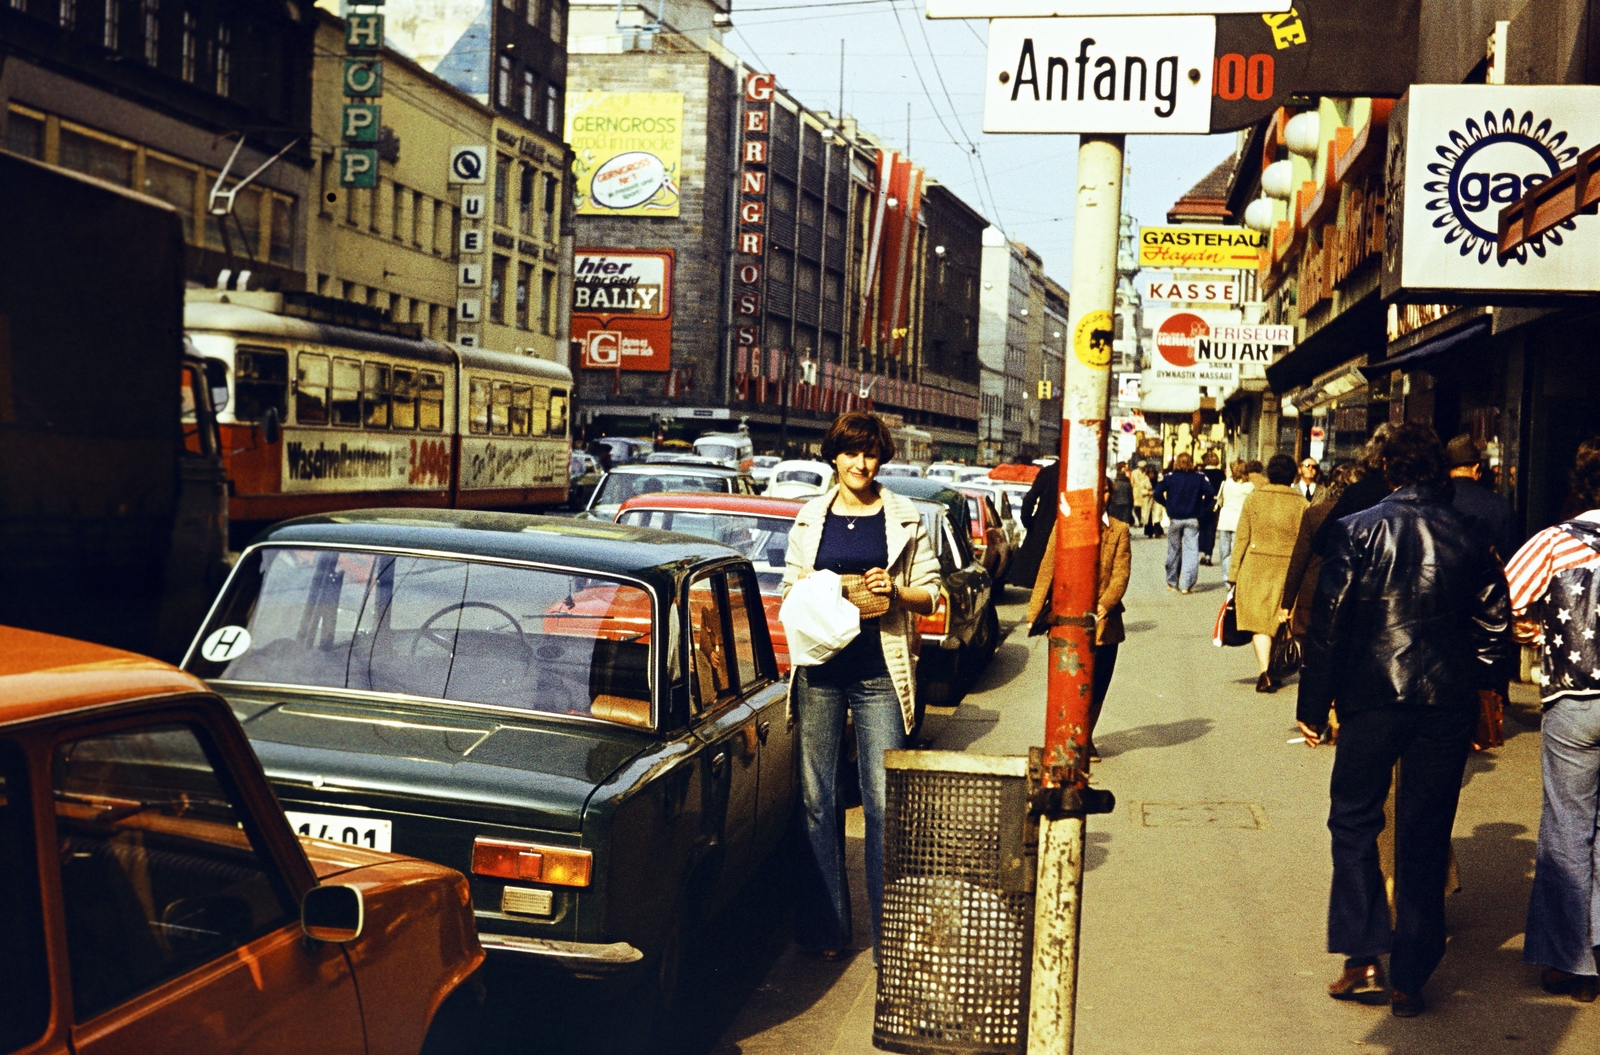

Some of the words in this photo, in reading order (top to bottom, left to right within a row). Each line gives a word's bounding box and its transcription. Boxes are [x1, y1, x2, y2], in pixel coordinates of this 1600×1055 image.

[1011, 38, 1178, 118] Anfang
[1212, 53, 1274, 101] 00
[343, 17, 377, 181] HOPP
[573, 116, 676, 133] GERNGROSS
[739, 75, 773, 346] GERNGROSS
[453, 151, 481, 346] QUELLE
[1143, 245, 1225, 266] Haydn
[576, 257, 633, 275] hier
[575, 286, 658, 310] BALLY
[1150, 283, 1234, 300] KASSE
[1214, 327, 1289, 341] FRISEUR
[590, 333, 618, 363] G
[1156, 370, 1197, 379] GYMNASTIK
[1199, 371, 1233, 381] MASSAGE
[210, 629, 243, 658] H
